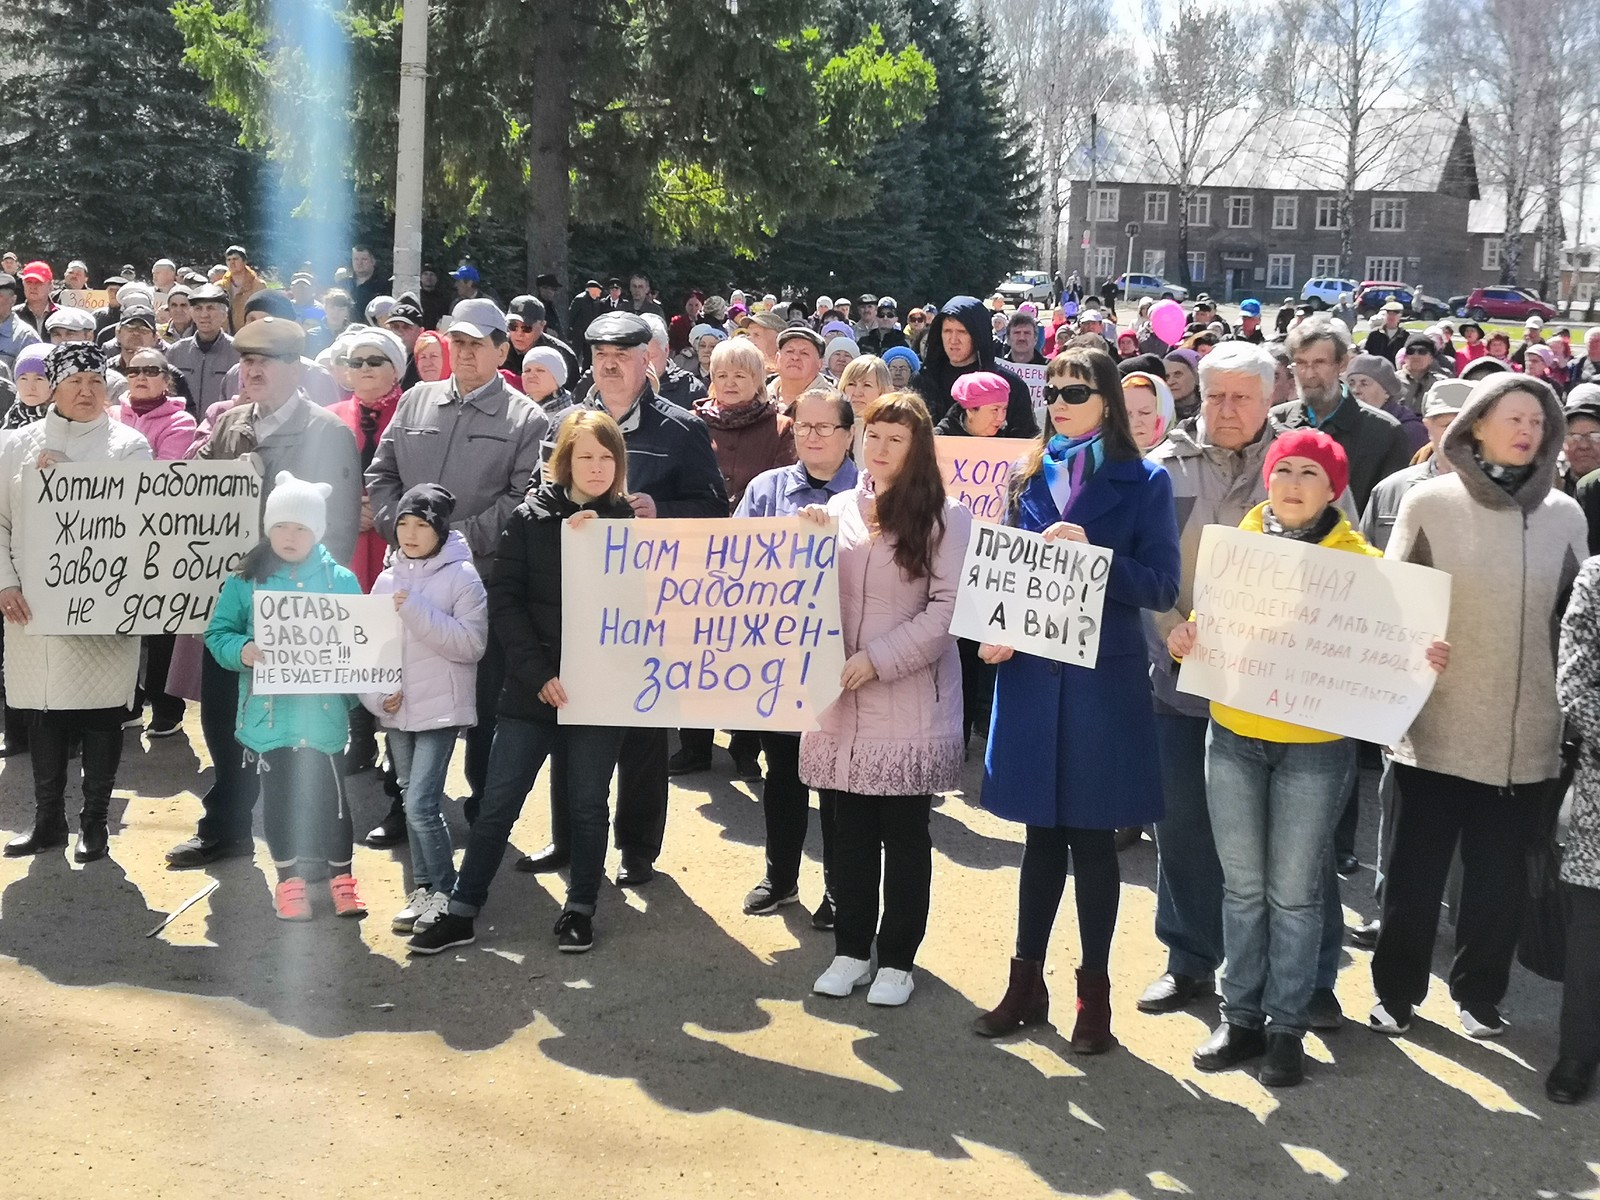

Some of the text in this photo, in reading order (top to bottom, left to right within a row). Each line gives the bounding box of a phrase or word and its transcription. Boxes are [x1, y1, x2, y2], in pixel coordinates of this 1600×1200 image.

[38, 462, 259, 505] Хотим работать
[55, 510, 250, 545] Жить хотим,
[45, 546, 128, 597] Завод
[144, 541, 161, 580] в
[604, 526, 837, 582] Нам нужна
[975, 528, 1110, 592] ПРОЦЕНКО,
[1210, 540, 1356, 602] ОЧЕРЕДНАЯ
[260, 596, 350, 621] ОСТАВЬ
[655, 570, 824, 615] работа!
[967, 565, 1088, 612] Я НЕ ВОР!
[1199, 584, 1320, 625] МНОГОДЕТНАЯ
[1327, 613, 1368, 634] МАТЬ
[67, 593, 215, 634] не дади
[263, 625, 368, 646] ЗАВОД В
[599, 607, 840, 652] Нам нужен-
[988, 601, 1097, 659] А ВЫ?
[1198, 613, 1296, 648] ПРЕКРАТИТЬ
[1305, 637, 1352, 659] РАЗВАЛ
[256, 667, 275, 684] НЕ
[281, 667, 332, 684] БУДЕТ
[633, 650, 811, 718] завод!
[1193, 644, 1276, 677] ПРЕЗИДЕНТ
[1285, 668, 1296, 683] И
